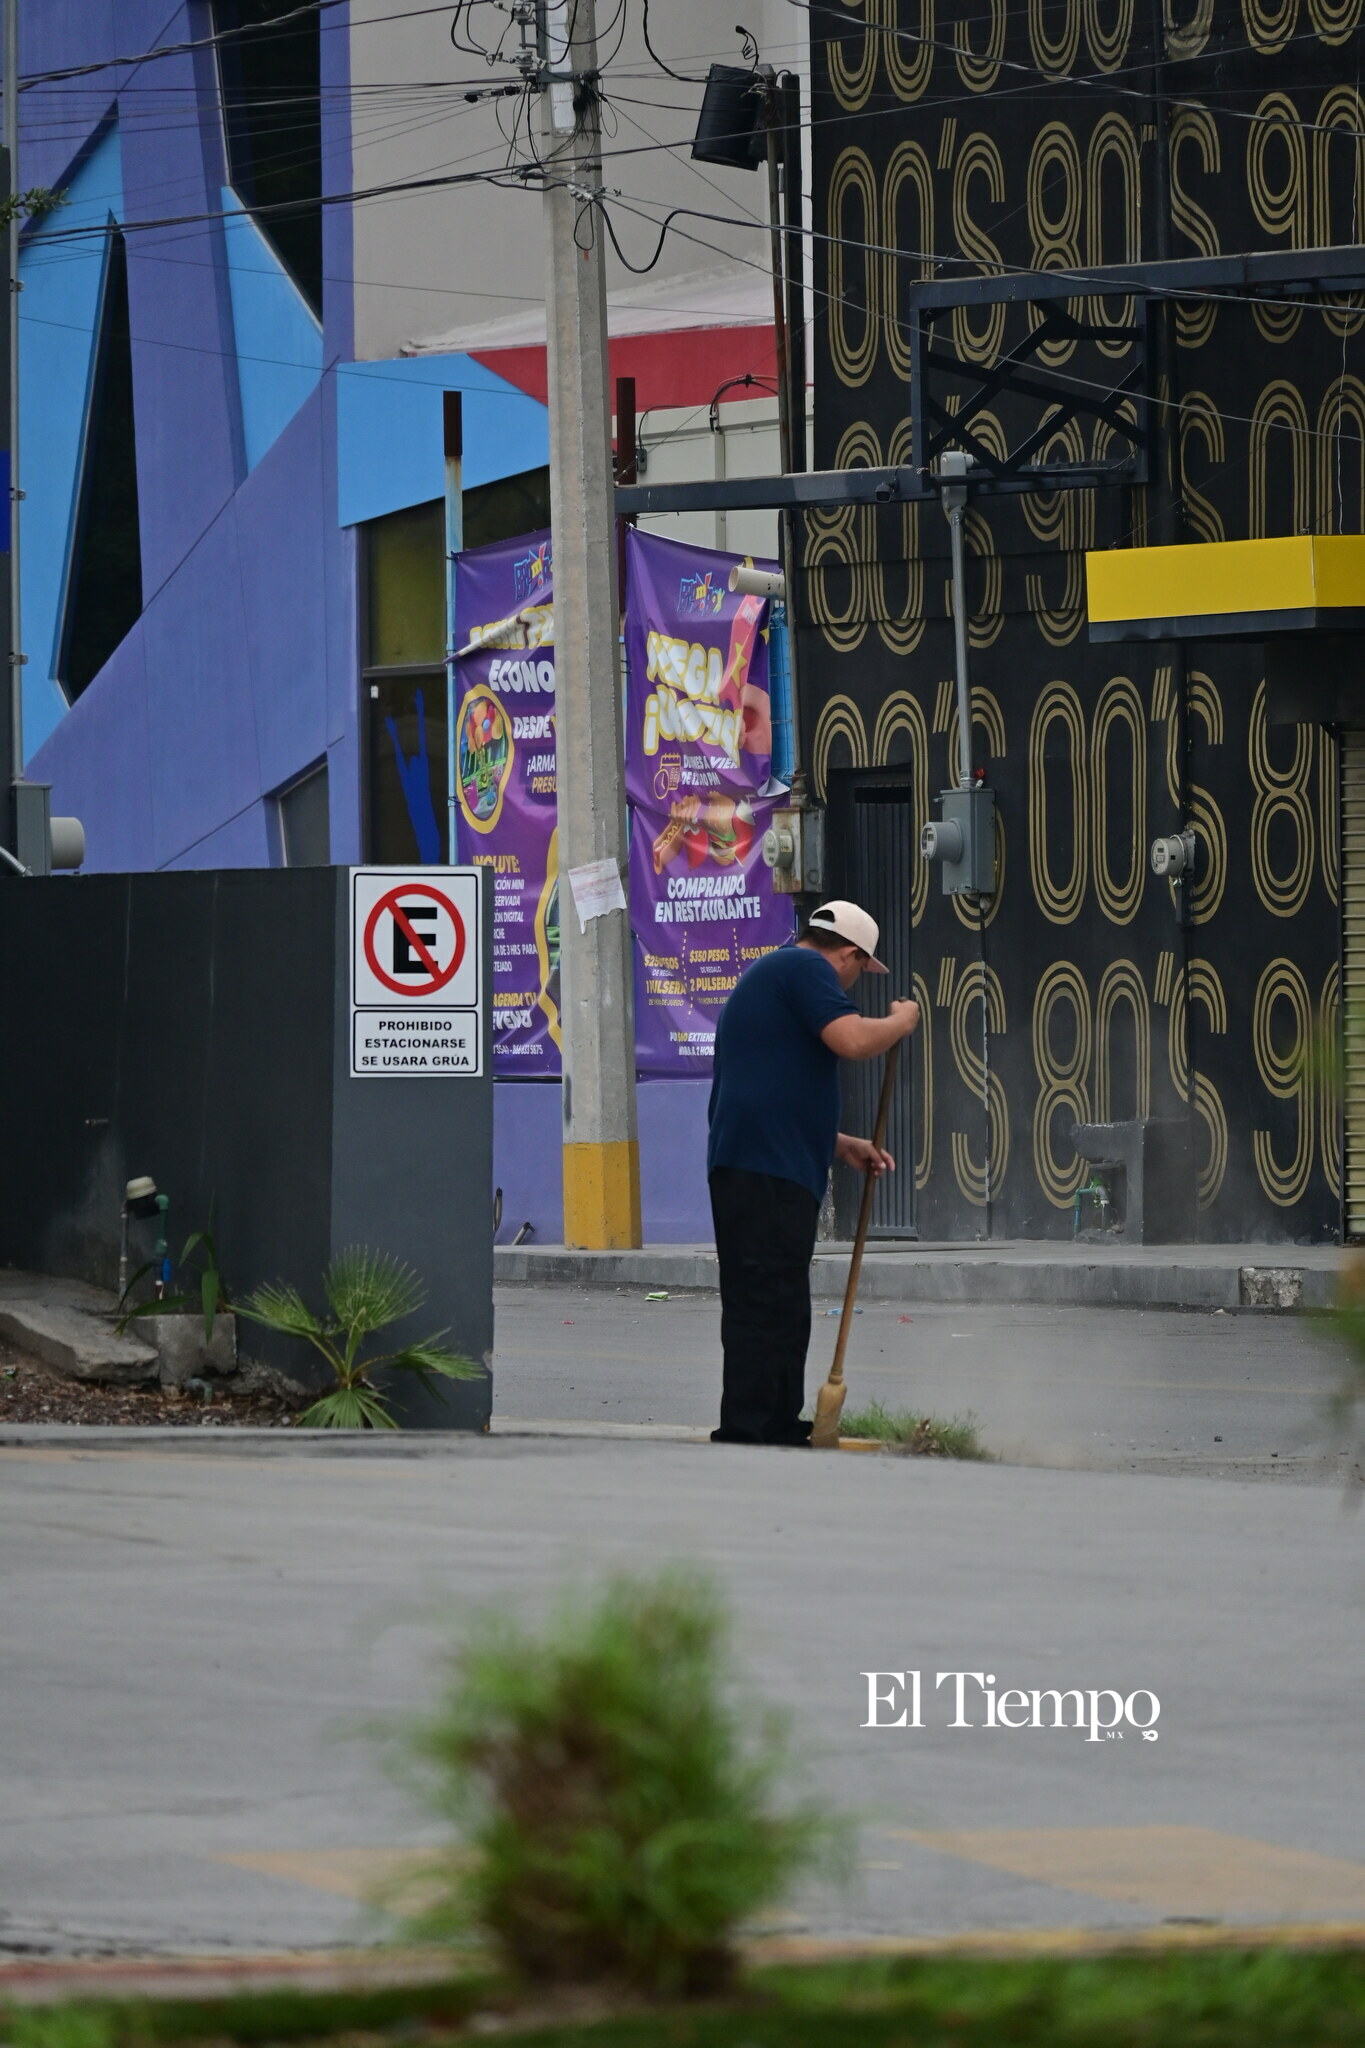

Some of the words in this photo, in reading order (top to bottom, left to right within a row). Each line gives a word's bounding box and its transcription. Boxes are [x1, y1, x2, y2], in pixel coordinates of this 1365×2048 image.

[513, 715, 552, 739] DESDE
[527, 754, 556, 776] ¡ARMA
[667, 874, 746, 899] COMPRANDO
[503, 911, 524, 922] DIGITAL
[655, 902, 673, 922] EN
[674, 896, 761, 922] RESTAURANTE
[393, 907, 438, 974] E
[707, 948, 730, 961] PESOS
[696, 976, 737, 992] PULSERAS
[493, 992, 523, 1007] AGENDA
[379, 1021, 452, 1031] PROHIBIDO
[365, 1038, 466, 1049] ESTACIONARSE
[362, 1056, 378, 1066] SE
[382, 1056, 428, 1066] USARA
[432, 1054, 469, 1066] GRÚA
